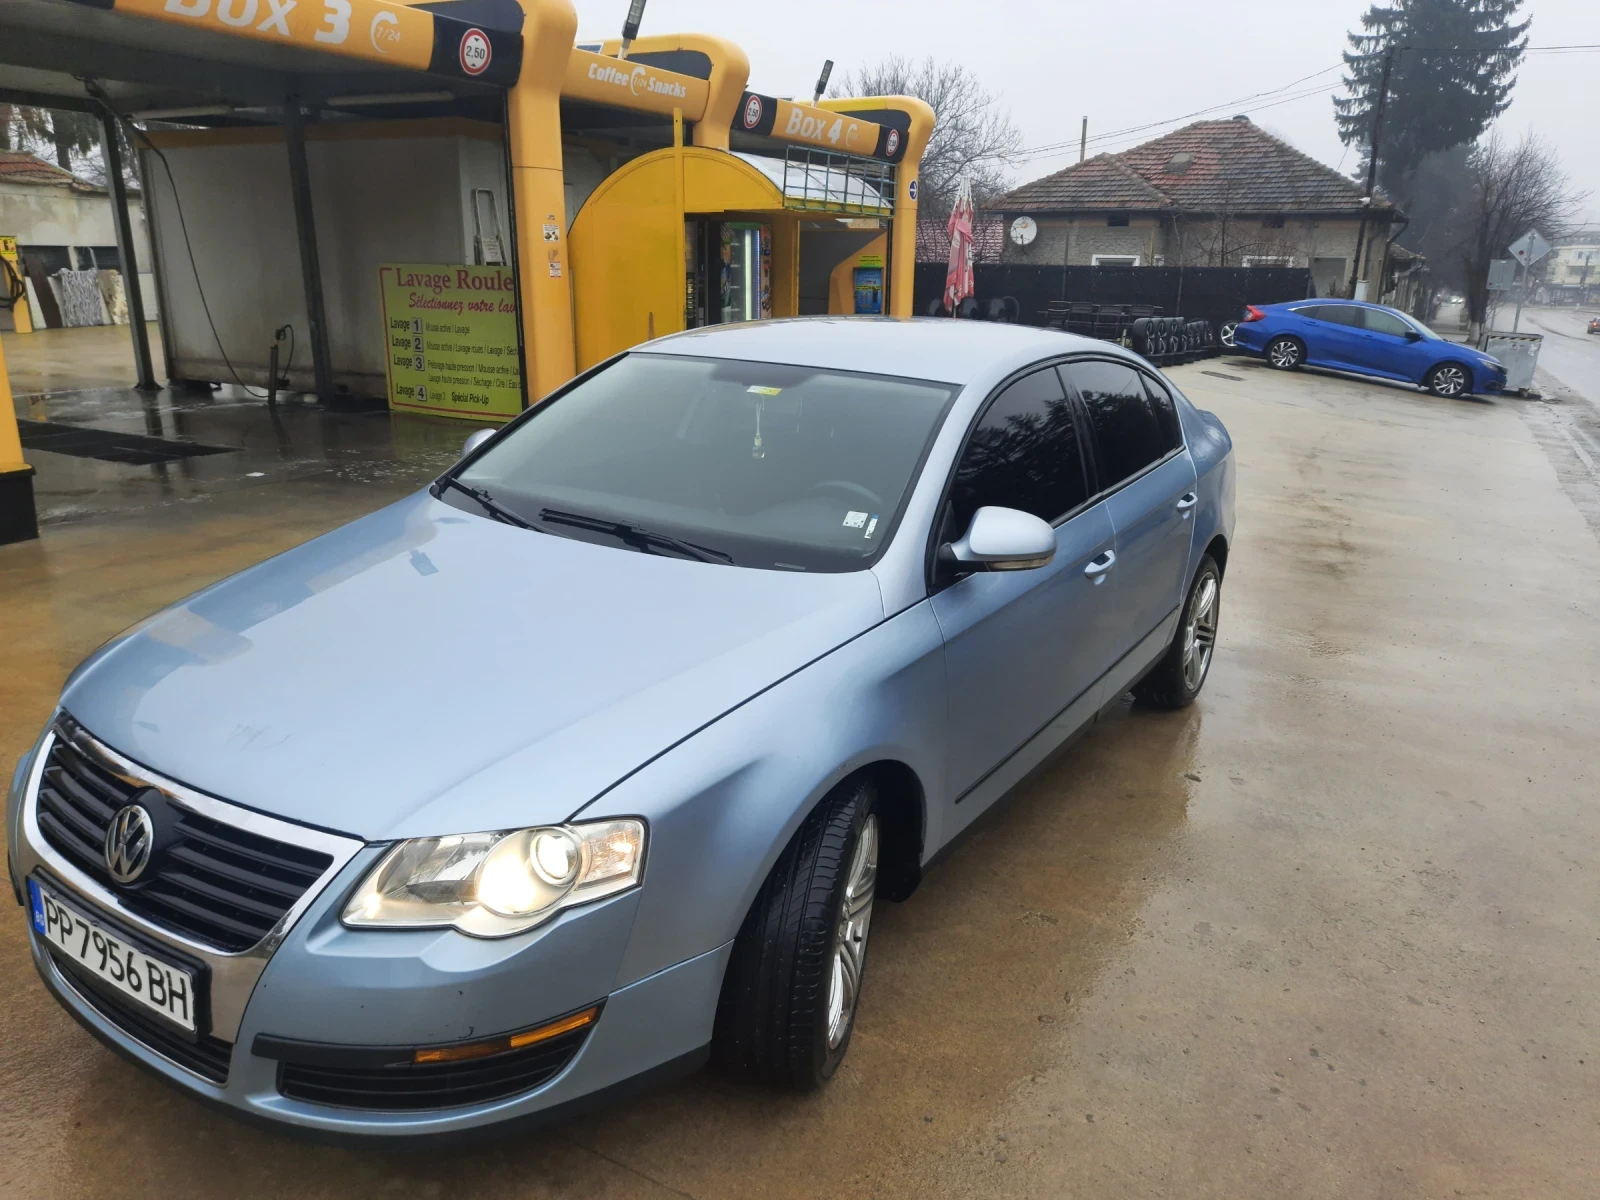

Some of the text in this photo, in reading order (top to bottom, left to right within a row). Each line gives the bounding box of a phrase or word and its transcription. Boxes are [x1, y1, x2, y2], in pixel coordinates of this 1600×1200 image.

[314, 0, 352, 45] 3
[374, 26, 401, 43] 7/24
[588, 63, 629, 86] Coffee
[647, 76, 687, 98] Snacks
[827, 118, 843, 145] 4
[396, 268, 514, 294] Lavage Roule
[408, 292, 464, 316] Sélectionnez
[468, 299, 494, 313] votre
[390, 317, 410, 332] Lavage
[413, 319, 419, 332] 1
[455, 324, 470, 336] Lavage
[392, 335, 411, 350] Lavage
[414, 338, 421, 350] 2
[456, 344, 471, 354] Lavage
[487, 345, 503, 356] Lavage
[393, 354, 413, 369] Lavage
[415, 357, 422, 370] 3
[478, 364, 495, 374] Mousse
[496, 365, 509, 375] active
[428, 372, 441, 384] Lavage
[453, 376, 470, 386] pression
[496, 378, 505, 388] Cire
[509, 379, 518, 389] Eau
[396, 383, 415, 398] Lavage
[417, 387, 424, 399] 4
[430, 389, 442, 402] Lavage
[469, 393, 490, 406] Pick-Up
[35, 910, 45, 926] BG
